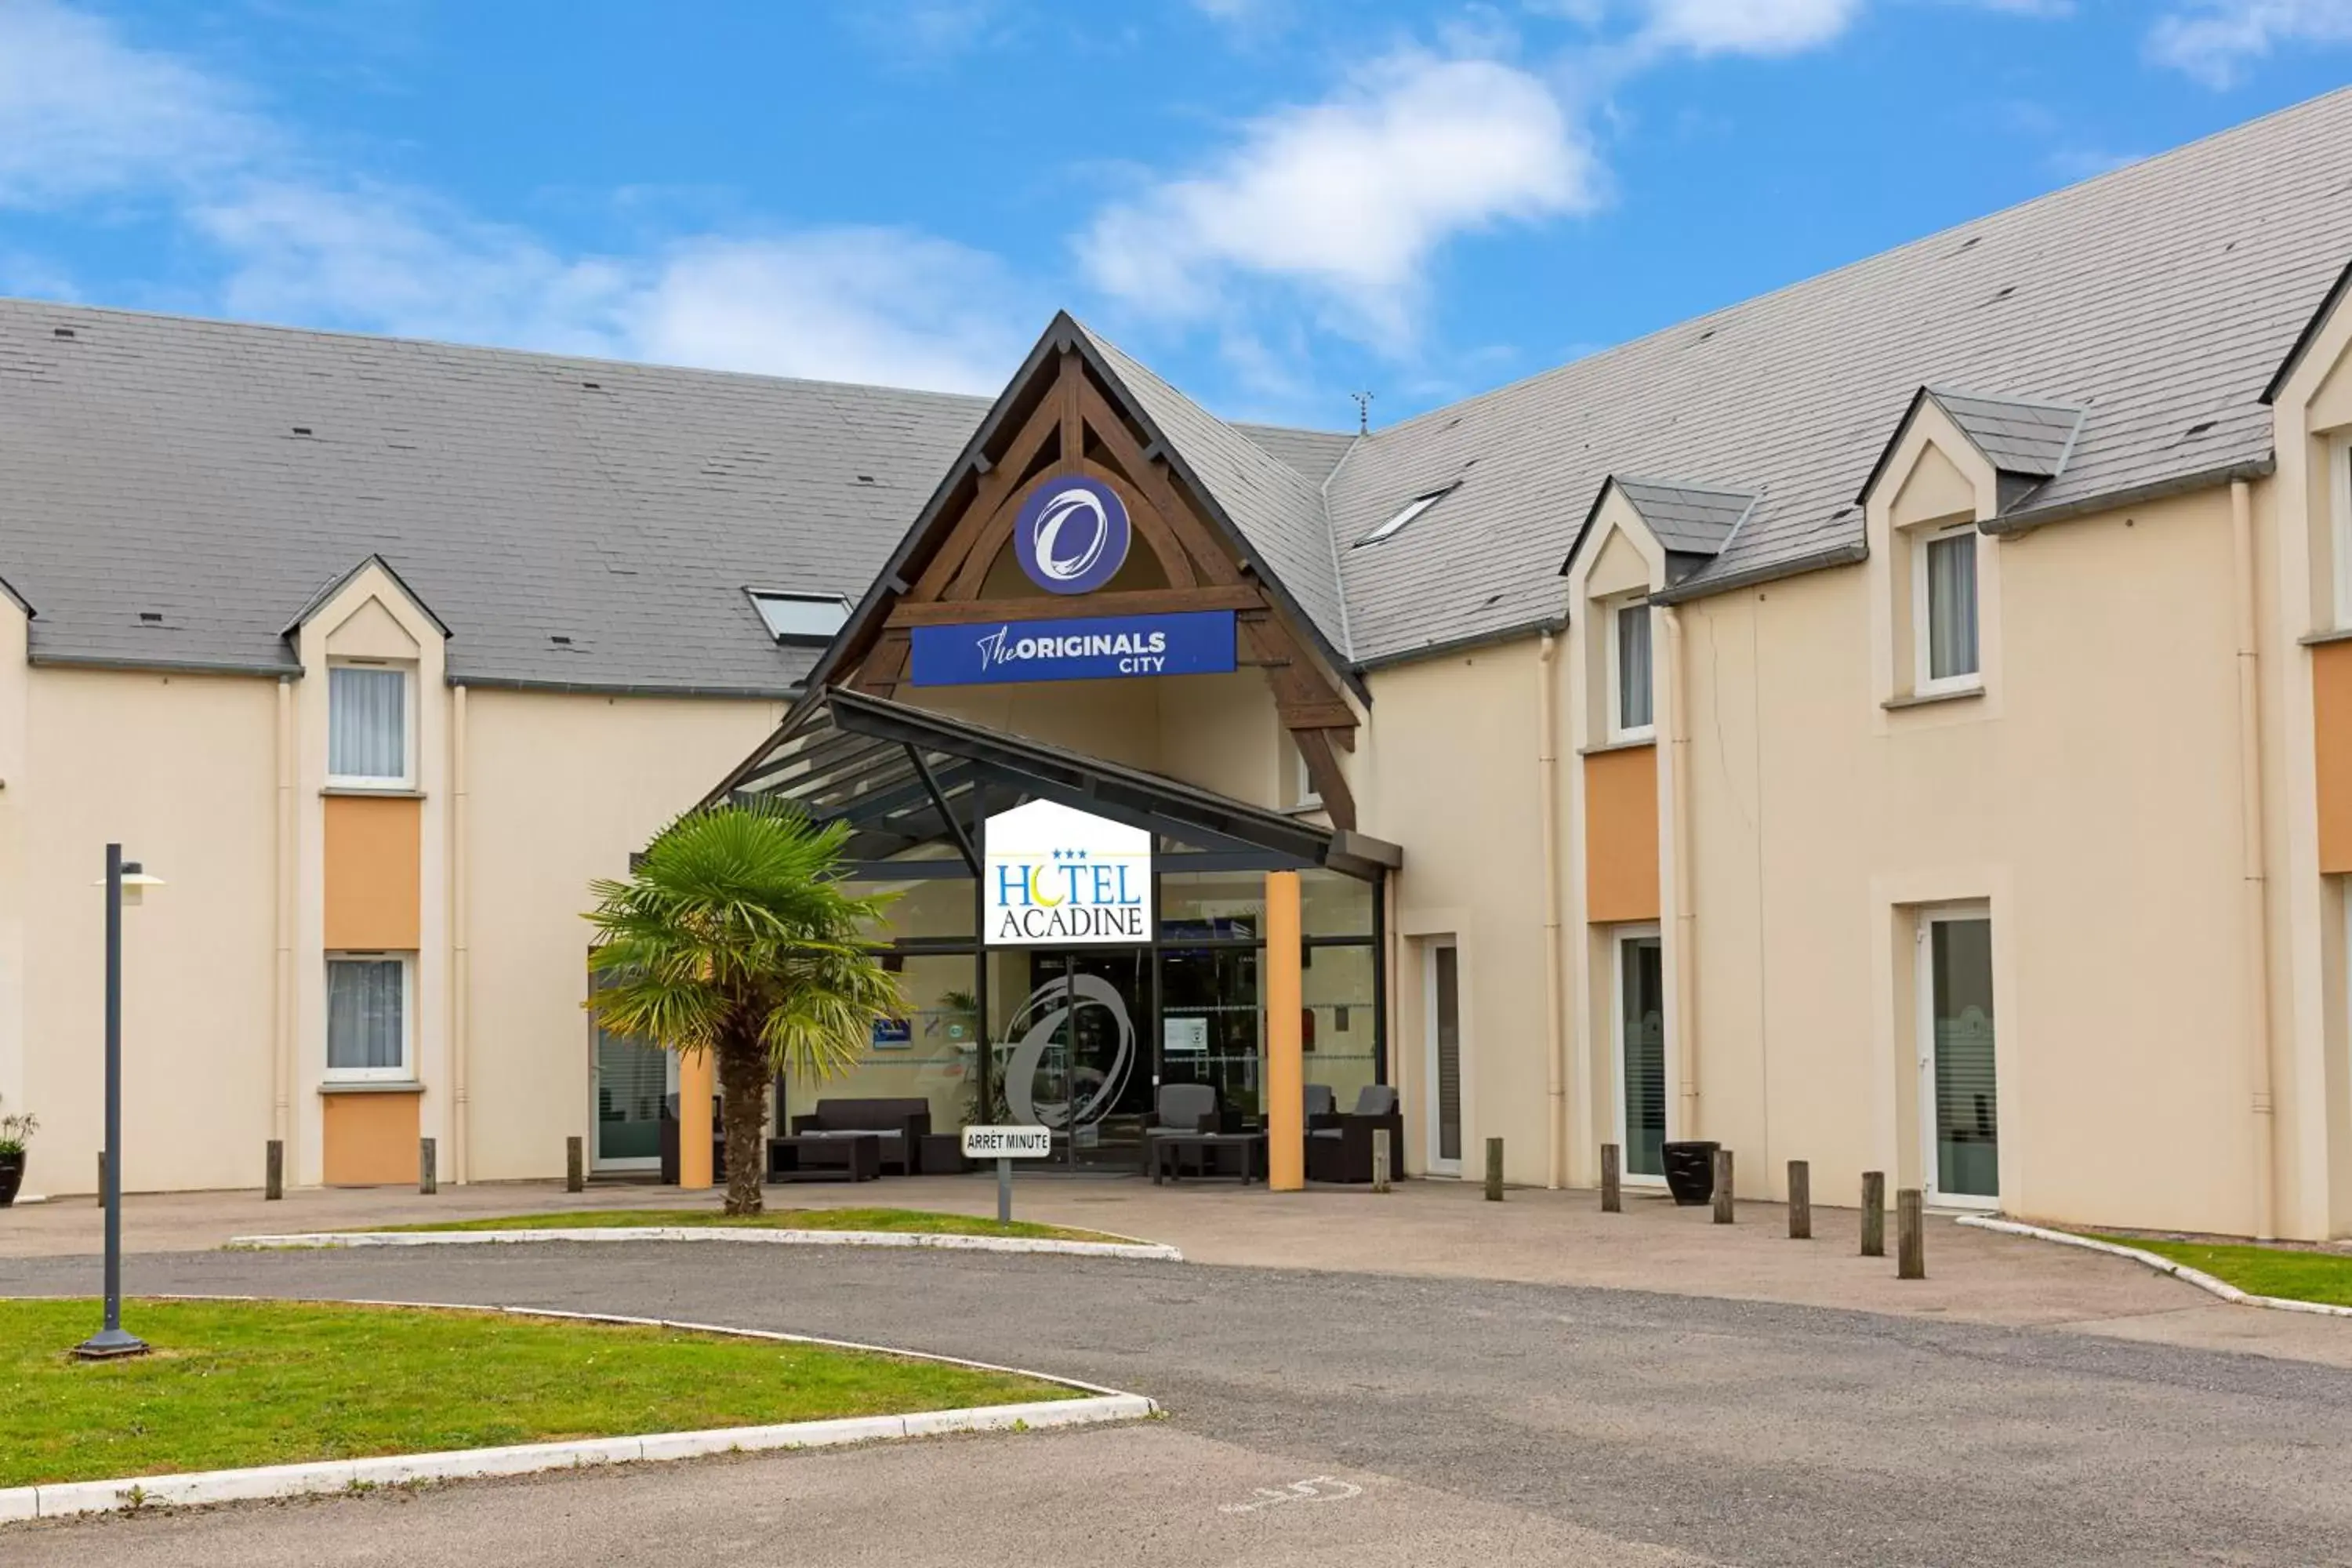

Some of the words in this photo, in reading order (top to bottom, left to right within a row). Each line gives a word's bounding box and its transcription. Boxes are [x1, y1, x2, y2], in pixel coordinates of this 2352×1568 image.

[1016, 632, 1167, 659] ORIGINALS
[1119, 656, 1165, 673] CITY
[996, 865, 1141, 907] HOTEL
[999, 908, 1143, 938] ACADINE
[1006, 1134, 1047, 1149] MINUTE
